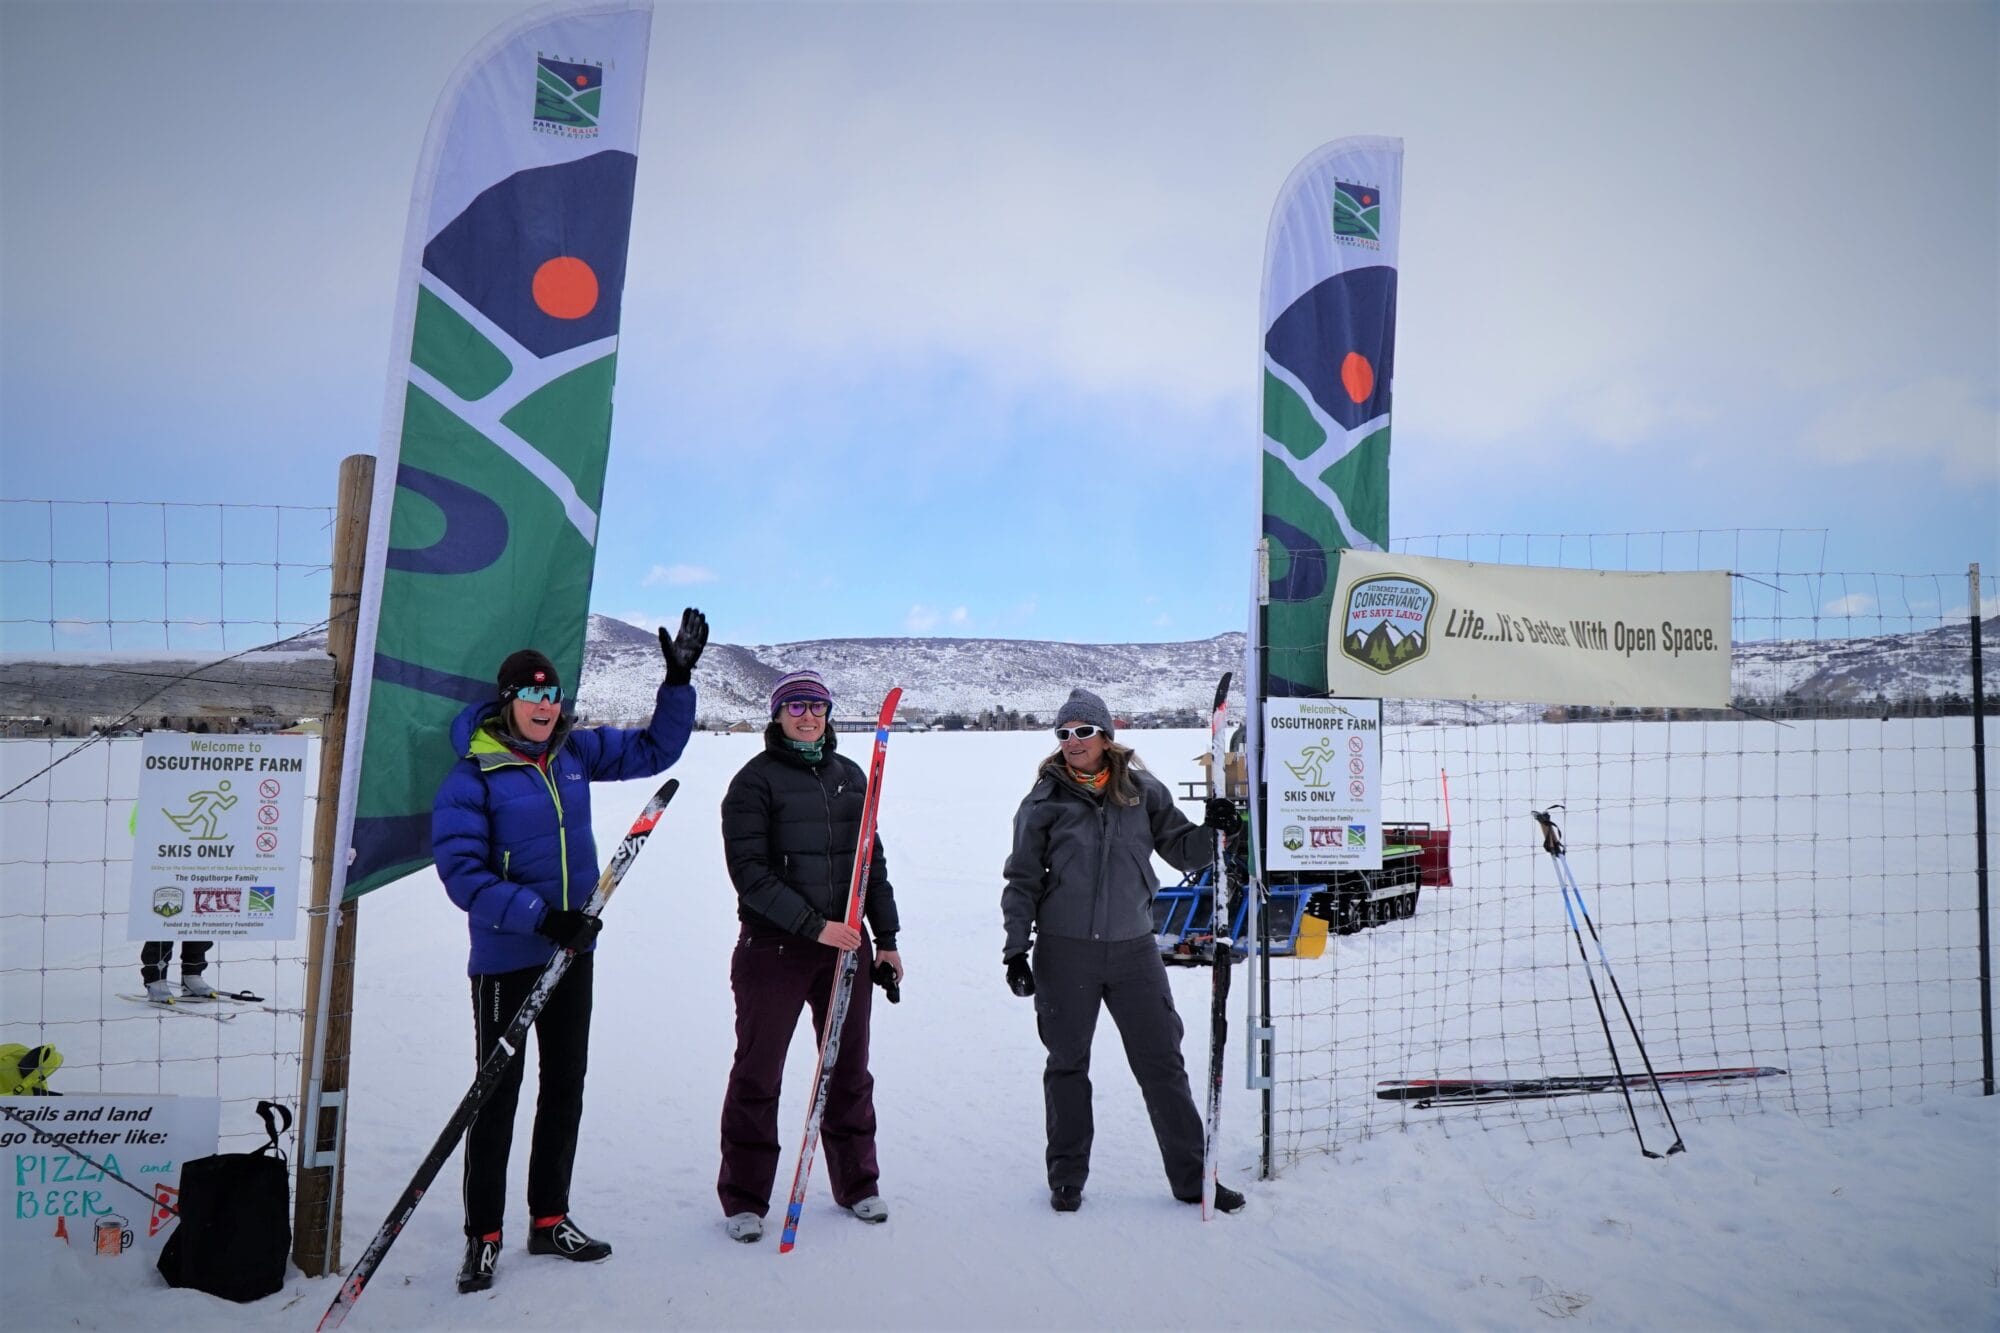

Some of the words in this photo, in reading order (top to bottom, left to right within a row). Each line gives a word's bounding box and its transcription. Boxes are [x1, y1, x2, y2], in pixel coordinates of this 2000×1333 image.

[533, 121, 562, 131] PARKS
[1367, 585, 1399, 593] SUMMIT
[1400, 586, 1420, 595] LAND
[1354, 592, 1429, 612] CONSERVANCY
[1352, 609, 1369, 620] WE
[1370, 608, 1394, 618] SAVE
[1395, 609, 1423, 622] LAND
[1522, 616, 1570, 647] Better
[1569, 620, 1608, 651] With
[1614, 620, 1656, 658] Open
[1662, 620, 1718, 658] Space.
[1300, 704, 1336, 714] Welcome
[1338, 705, 1348, 715] to
[1271, 717, 1344, 730] OSGUTHORPE
[1347, 718, 1376, 730] FARM
[191, 740, 245, 753] Welcome
[249, 742, 262, 753] to
[145, 756, 254, 772] OSGUTHORPE
[259, 758, 303, 772] FARM
[1284, 791, 1307, 802] SKIS
[1310, 791, 1336, 802] ONLY
[158, 845, 192, 858] SKIS
[197, 845, 235, 858] ONLY
[191, 874, 233, 882] Osguthorpe
[235, 874, 259, 882] Family
[493, 981, 501, 1023] SALOMON
[4, 1106, 59, 1122] Trails
[63, 1106, 102, 1122] and
[107, 1106, 153, 1122] land
[0, 1132, 27, 1148] go
[32, 1129, 120, 1148] together
[124, 1129, 169, 1145] like:
[16, 1153, 124, 1186] PIZZA
[139, 1160, 174, 1175] and
[16, 1190, 113, 1219] BEER
